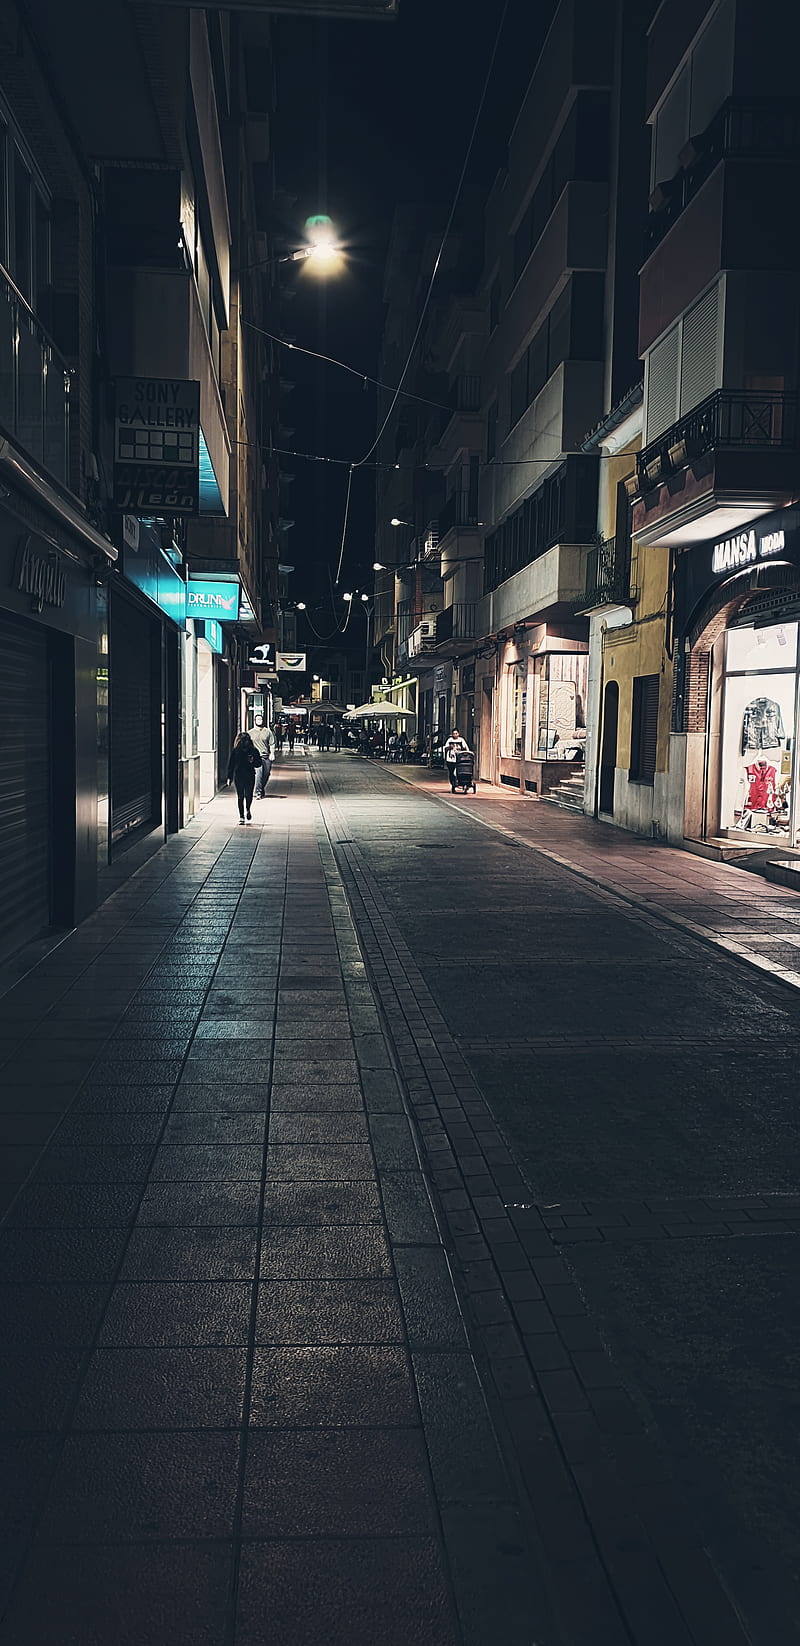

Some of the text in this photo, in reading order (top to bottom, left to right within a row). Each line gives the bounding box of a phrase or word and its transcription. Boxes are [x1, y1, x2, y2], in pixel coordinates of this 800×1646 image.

[135, 381, 180, 404] SONY
[118, 404, 194, 428] GALLERY
[712, 530, 785, 573] MANSA MODA
[188, 592, 222, 605] DRUNI
